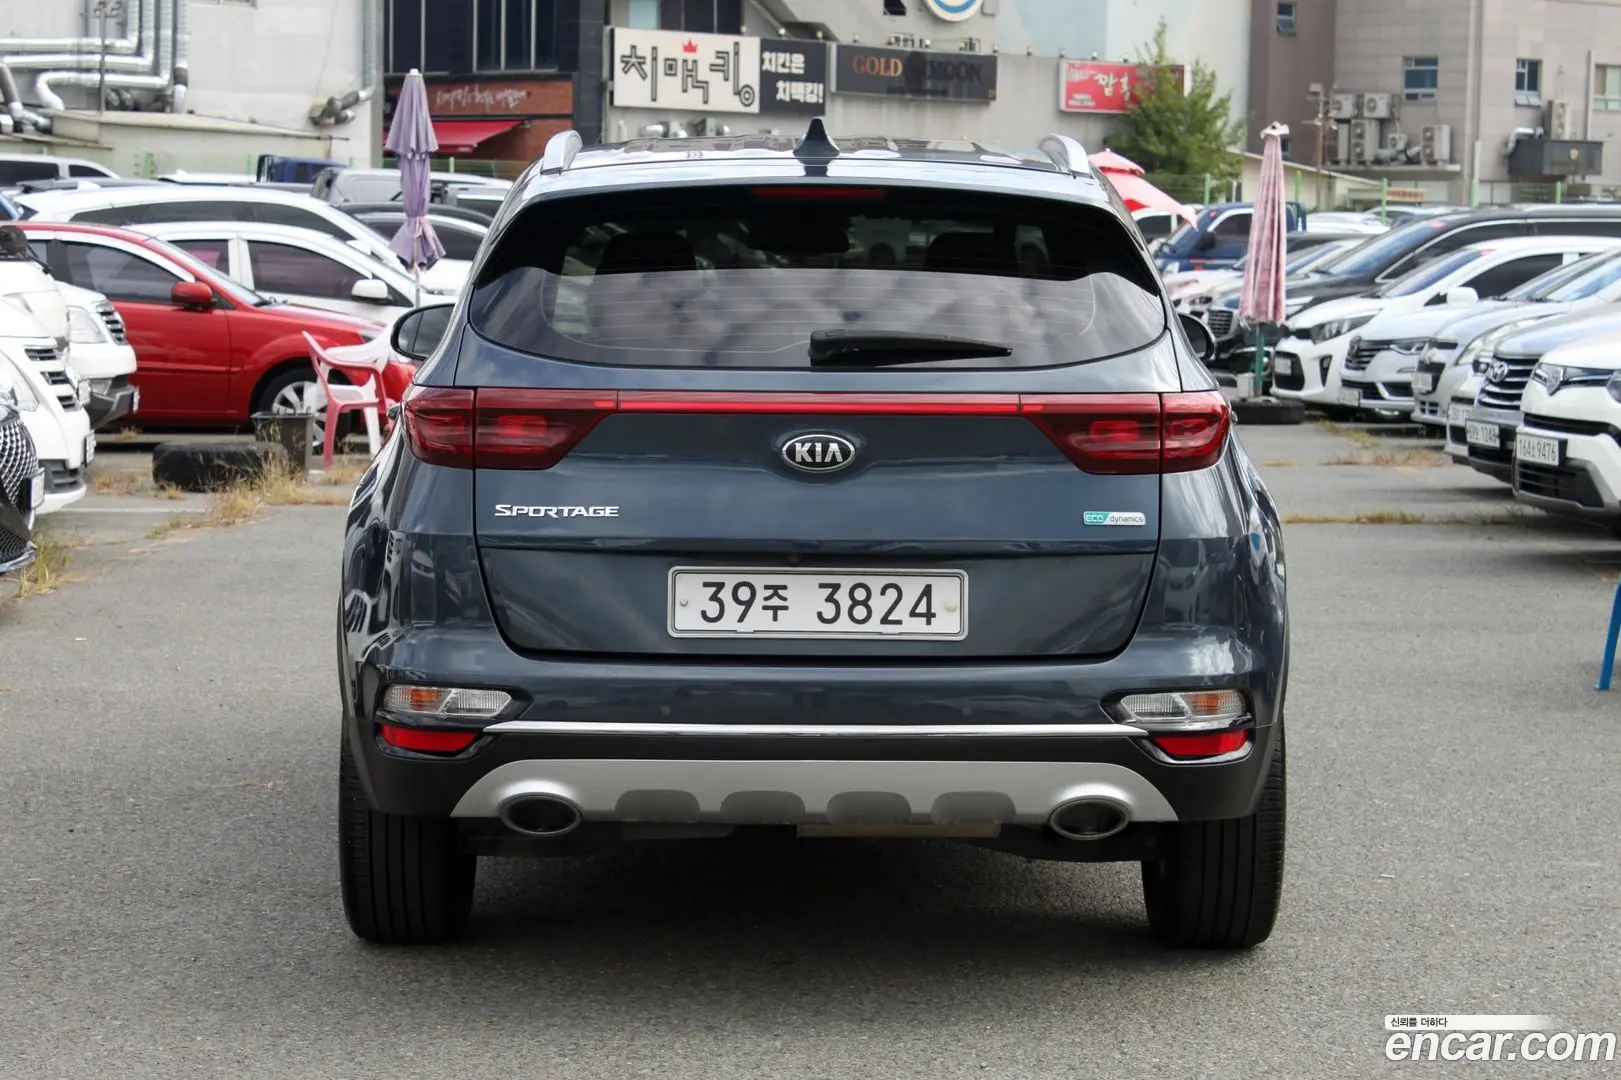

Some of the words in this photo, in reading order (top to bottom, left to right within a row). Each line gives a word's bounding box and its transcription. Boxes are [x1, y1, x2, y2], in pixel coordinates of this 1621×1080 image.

[620, 41, 755, 107] 치맥킹
[762, 51, 805, 75] 치킨은
[852, 55, 903, 77] GOLD
[794, 442, 843, 463] KIA
[494, 504, 620, 518] SPORTAGE
[700, 580, 789, 623] 39주
[816, 582, 937, 626] 3824
